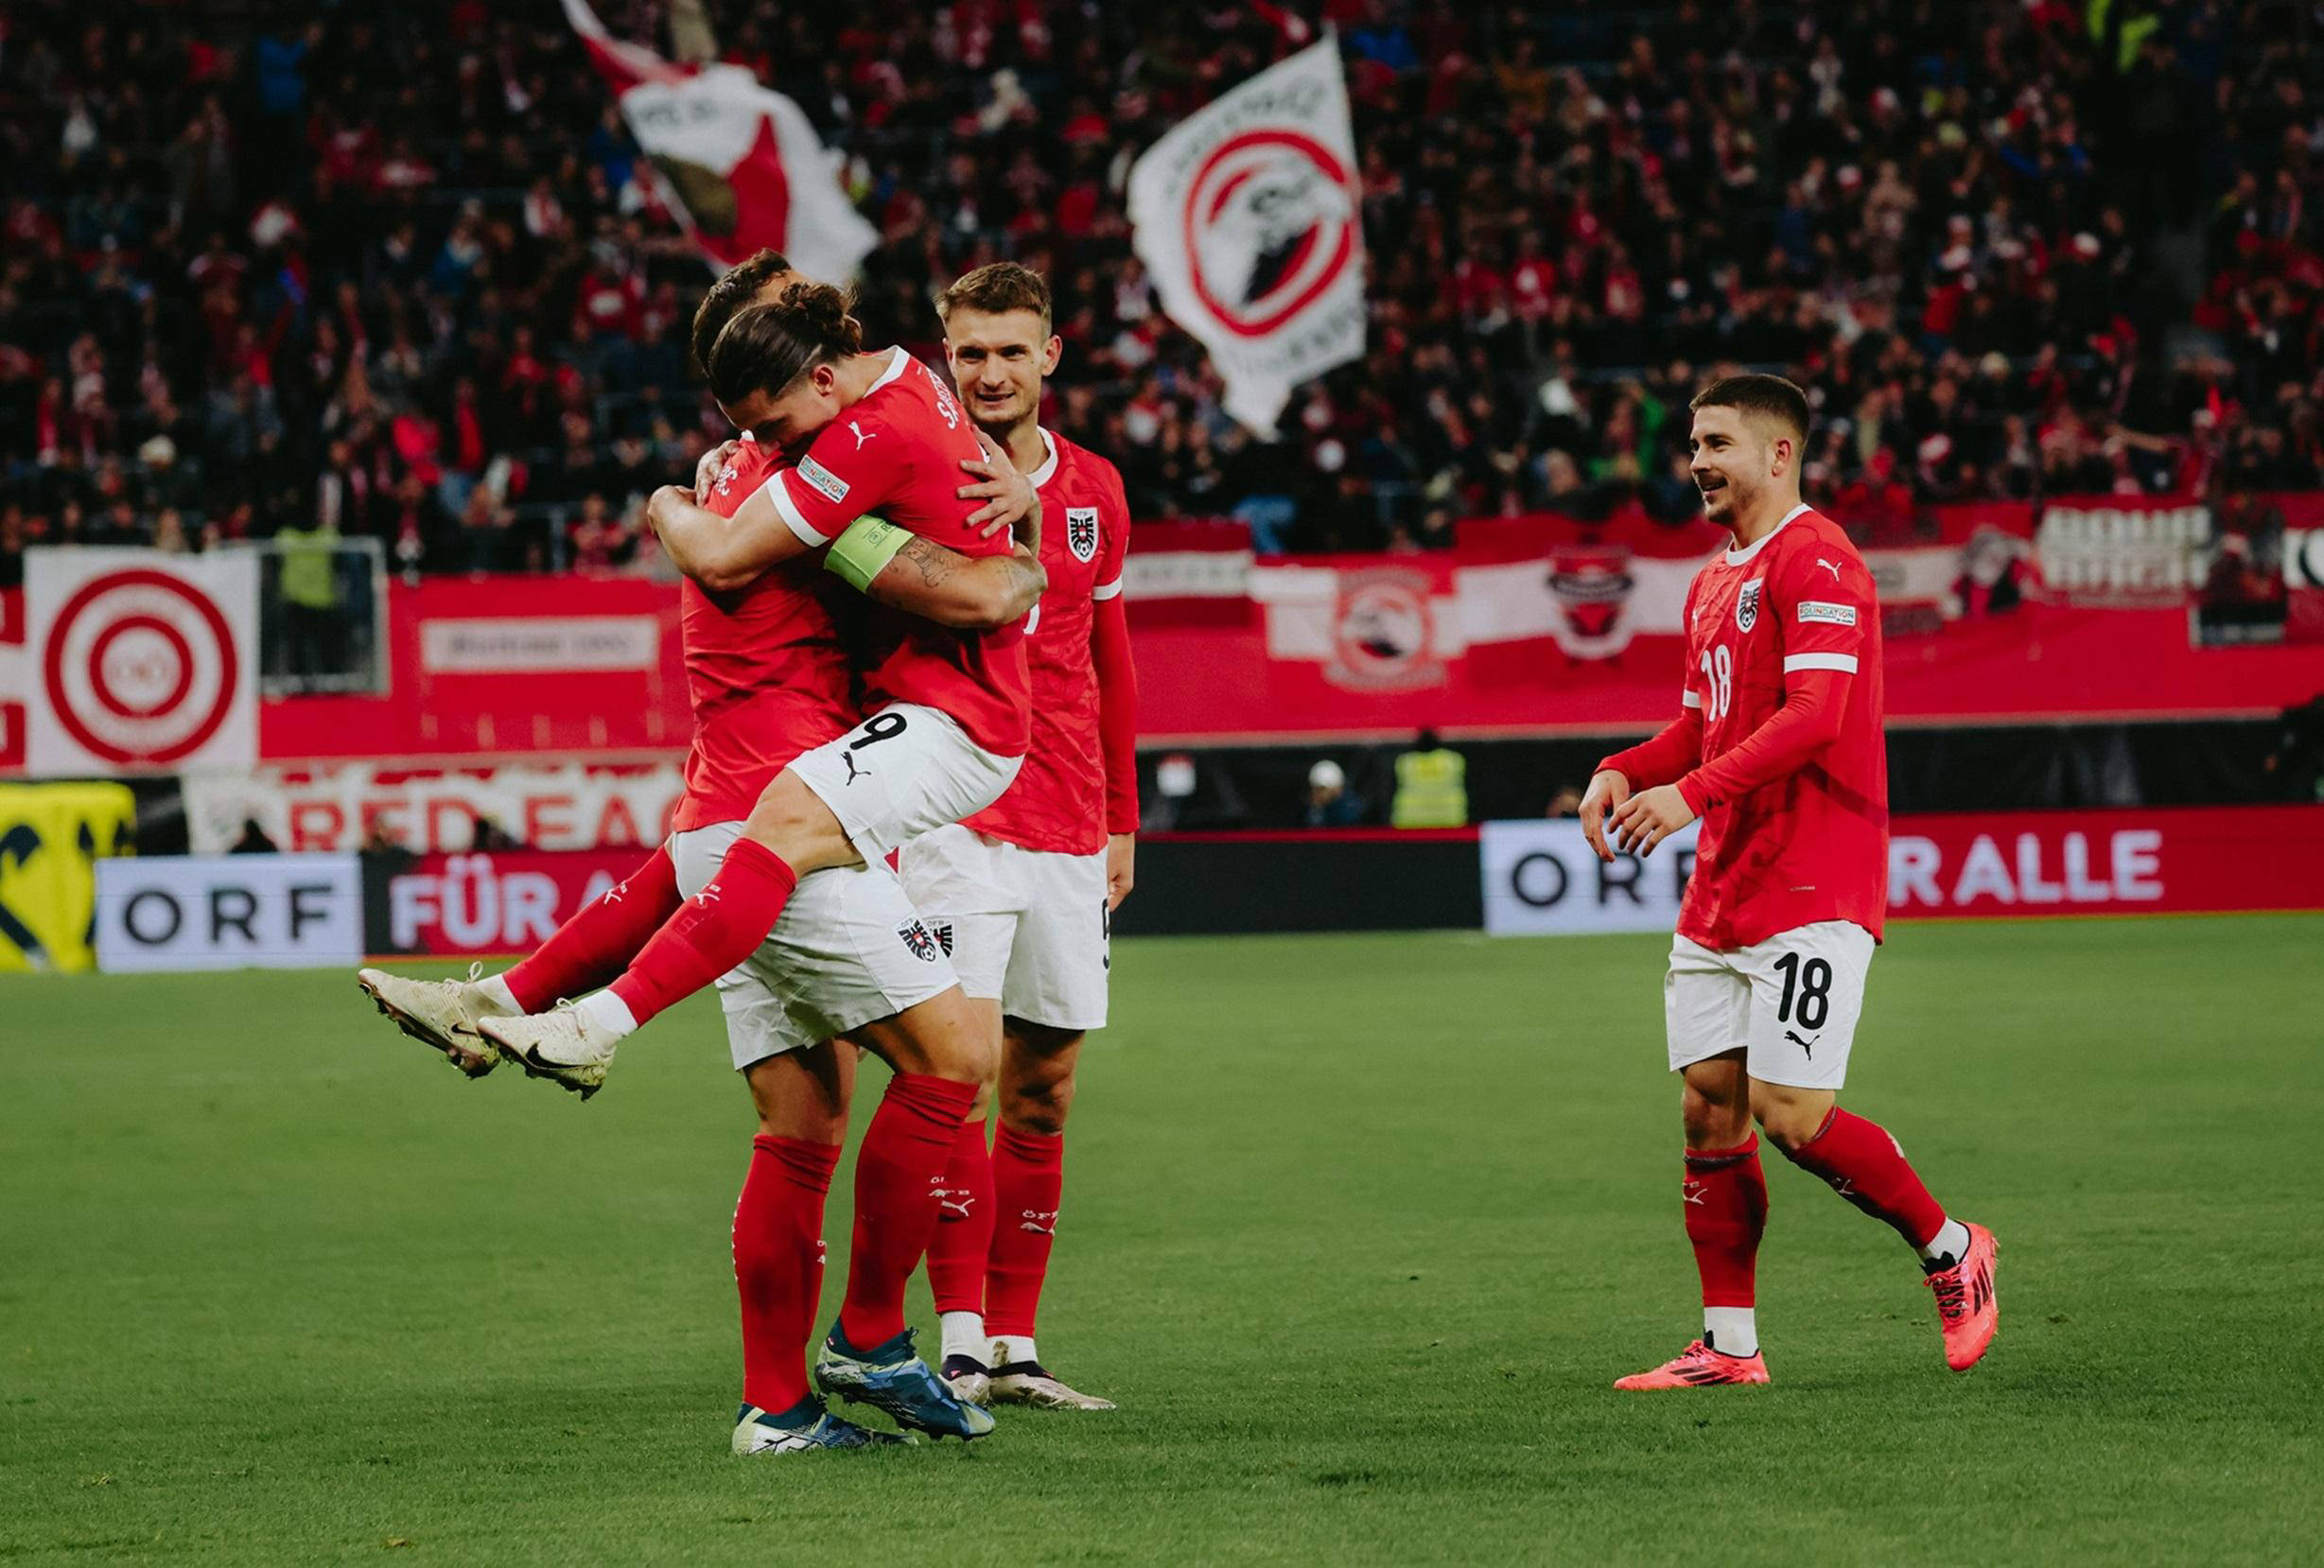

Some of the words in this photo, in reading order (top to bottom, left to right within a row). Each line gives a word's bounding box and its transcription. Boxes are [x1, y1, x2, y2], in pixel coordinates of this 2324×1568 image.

[1800, 606, 1854, 619] FOUNDATION
[1701, 644, 1732, 723] 18
[849, 712, 908, 750] 9
[289, 797, 479, 851] RED
[124, 885, 335, 945] ORF
[390, 853, 562, 949] FÜR
[1952, 829, 2165, 905] ALLE
[1774, 951, 1833, 1030] 18
